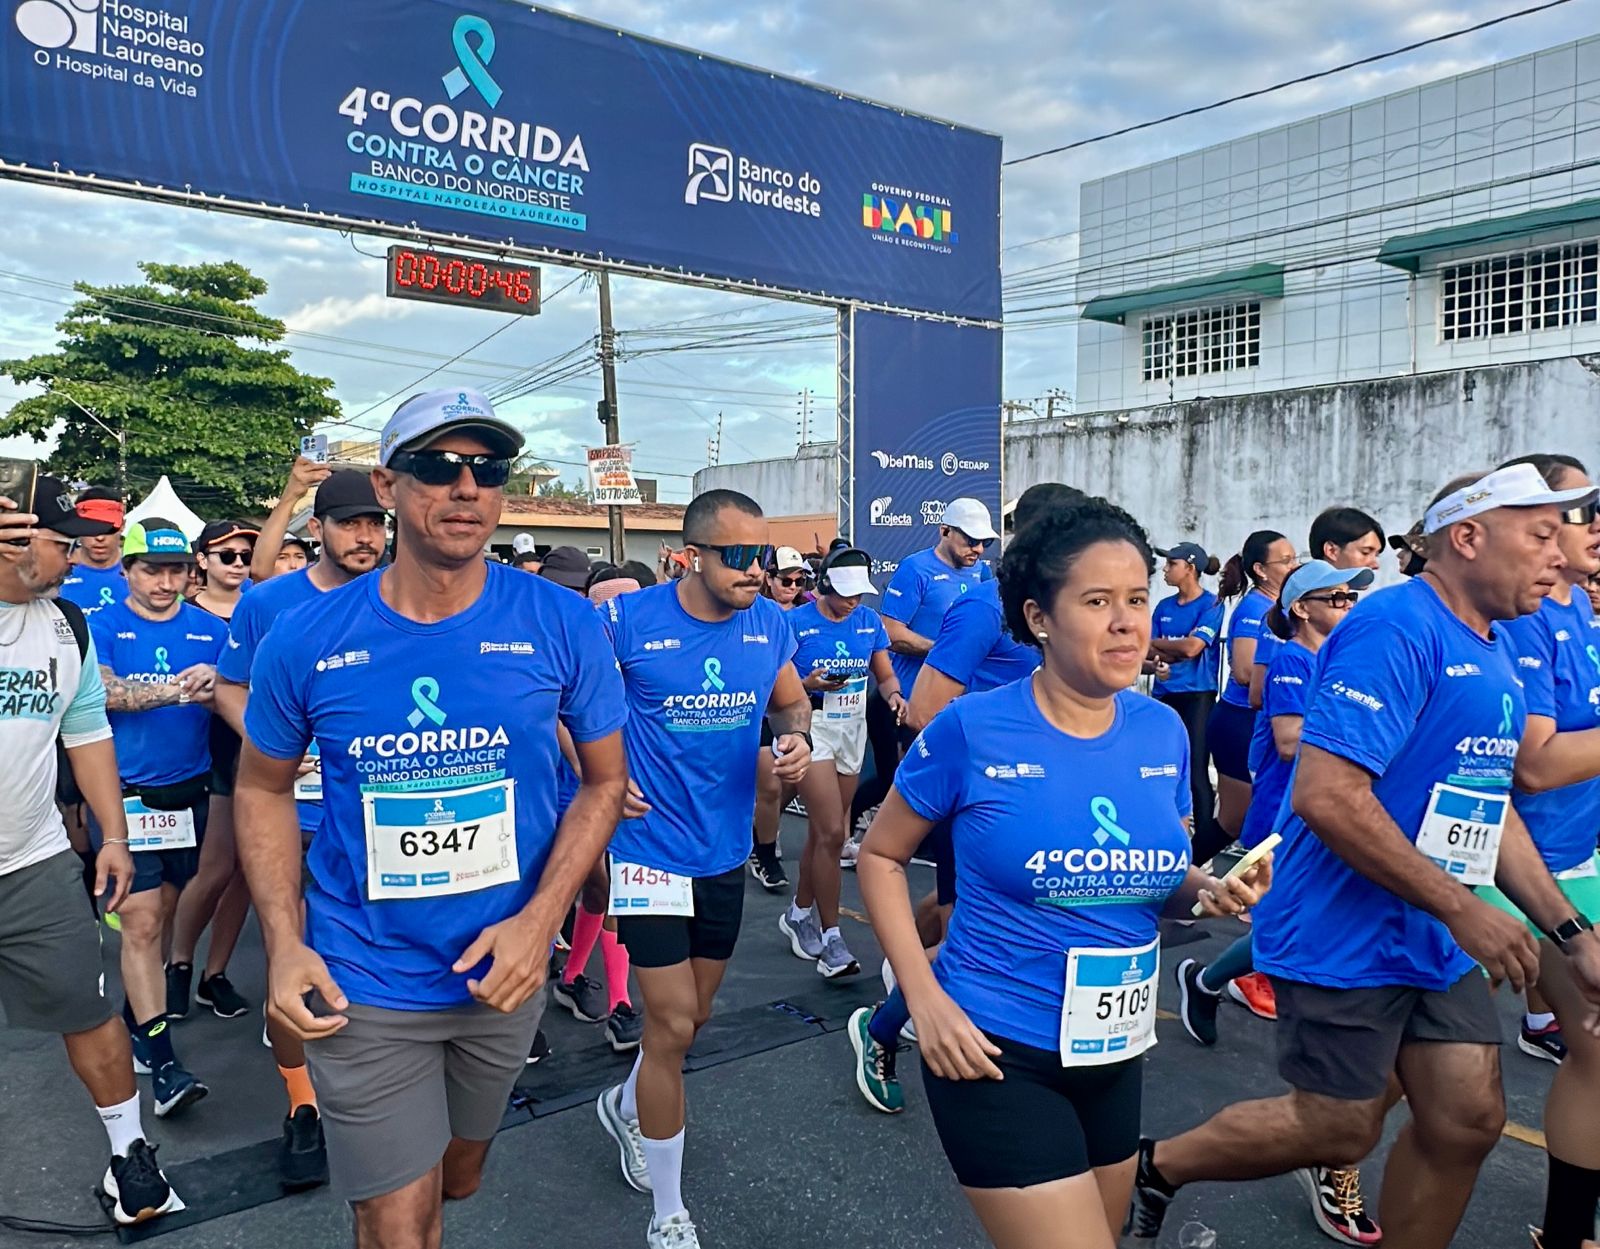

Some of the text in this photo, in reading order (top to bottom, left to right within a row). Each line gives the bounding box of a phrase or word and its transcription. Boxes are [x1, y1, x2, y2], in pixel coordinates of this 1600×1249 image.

[103, 0, 188, 33] Hospital
[103, 38, 204, 77] Laureano
[34, 50, 197, 98] O Hospital da Vida
[347, 131, 584, 196] CONTRA O CÂNCER
[739, 157, 821, 195] Banco do
[371, 161, 571, 211] BANCO DO NORDESTE
[739, 181, 821, 218] Nordeste
[871, 182, 951, 207] GOVERNO FEDERAL
[357, 181, 580, 227] HOSPITAL NAPOLEÃO LAUREANO
[863, 193, 958, 245] BRASIL
[872, 233, 894, 244] UNIÃO
[902, 239, 952, 254] RECONSTRUÇÃO
[396, 251, 532, 304] 00:00:46
[959, 460, 990, 471] CEDAPP
[870, 499, 912, 526] Projecta
[153, 536, 185, 547] HOKA
[665, 704, 753, 719] CONTRA O CÂNCER
[672, 717, 700, 726] BANCO
[712, 713, 746, 725] NORDESTE
[355, 748, 506, 773] CONTRA O CÂNCER
[368, 762, 497, 784] BANCO DO NORDESTE
[139, 814, 177, 830] 1136
[399, 823, 480, 857] 6347
[1447, 823, 1489, 850] 6111
[621, 866, 672, 886] 1454
[1031, 874, 1108, 889] CONTRA
[1112, 873, 1125, 886] O
[1048, 887, 1172, 898] BANCO DO NORDESTE
[1096, 984, 1150, 1020] 5109
